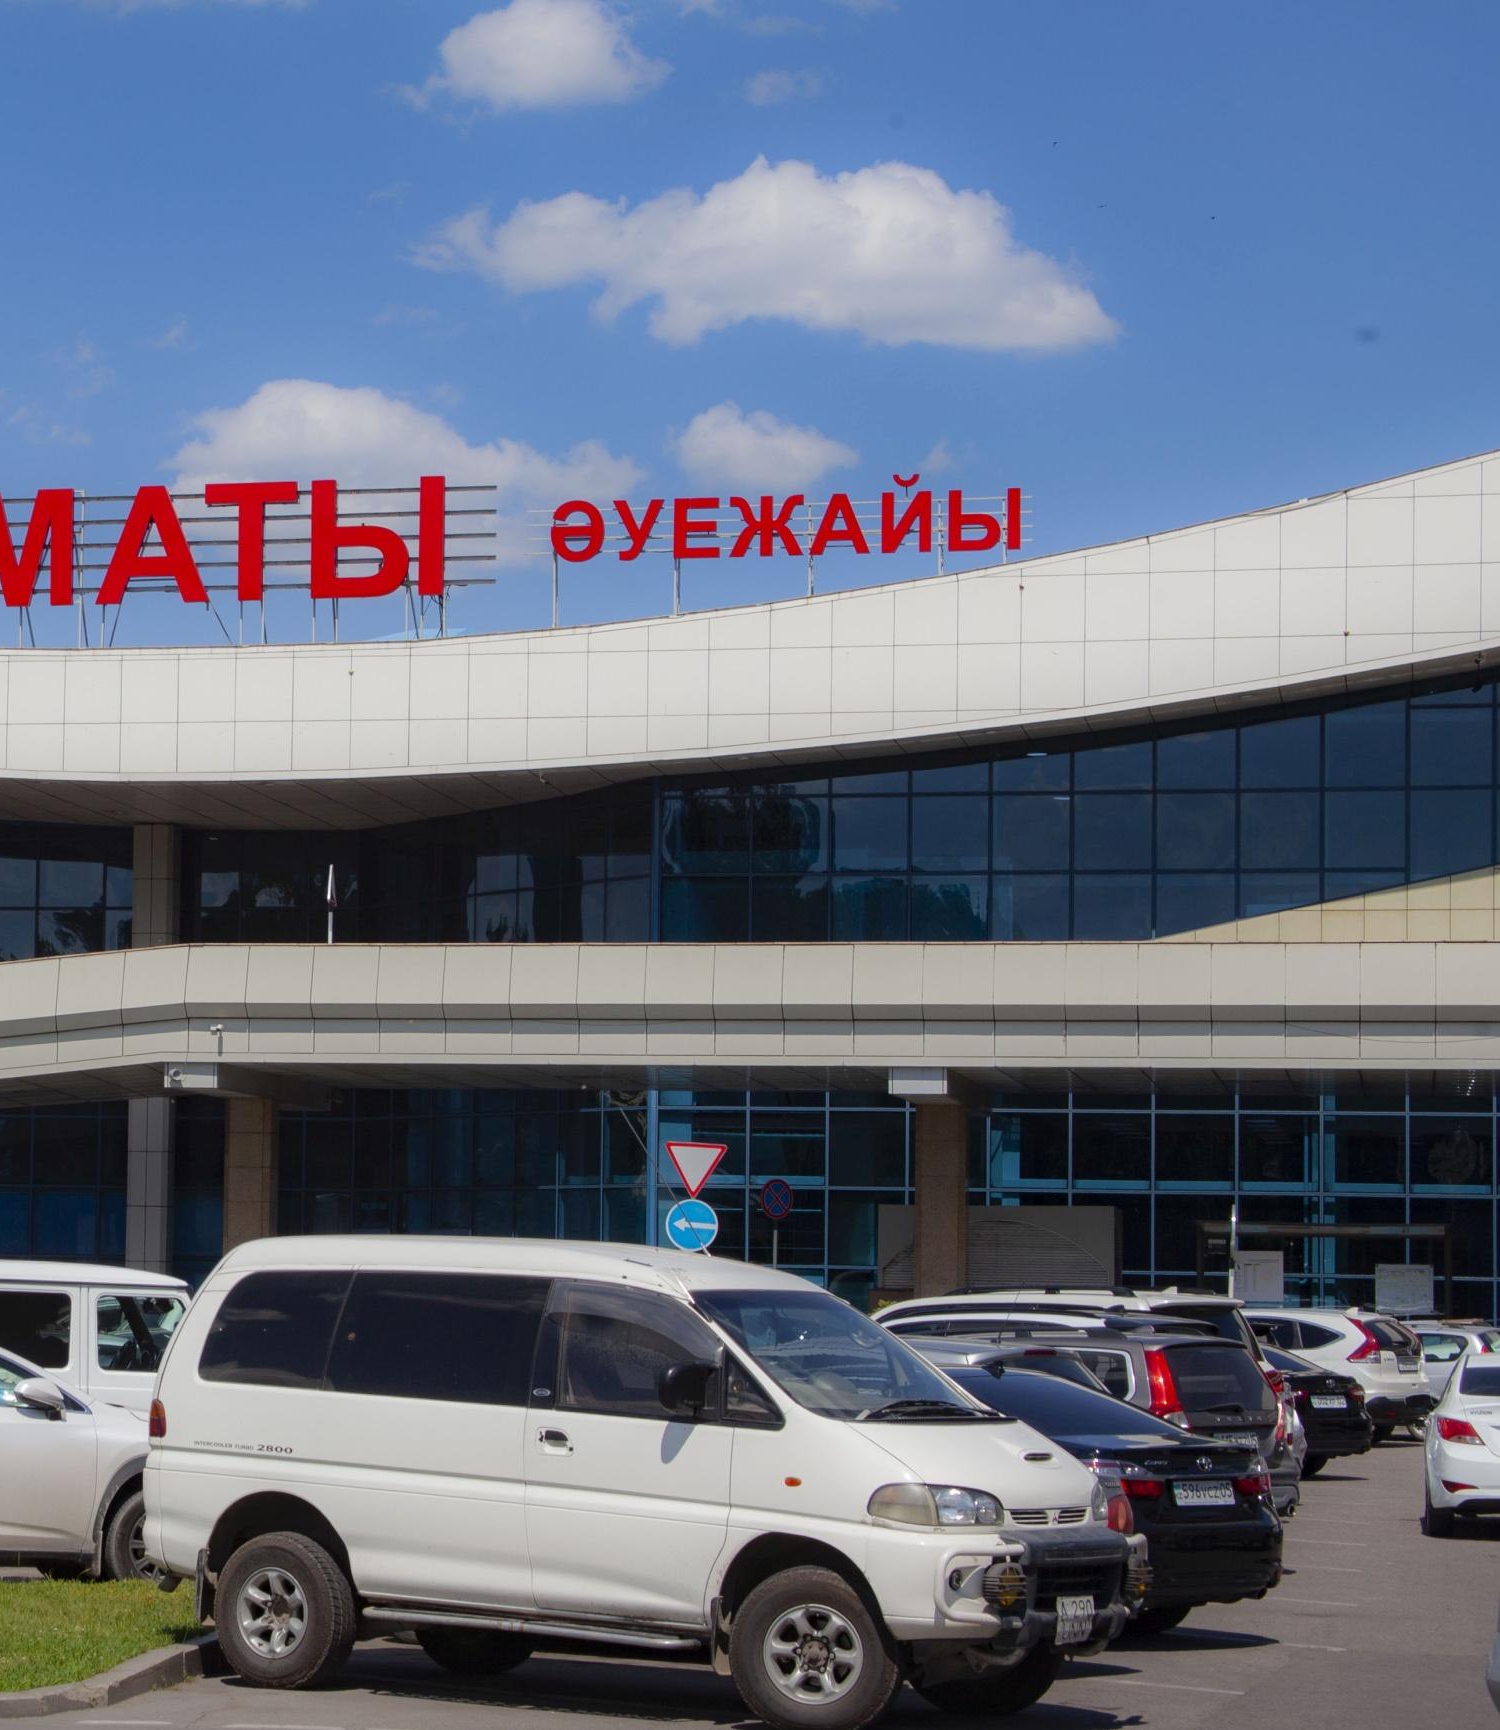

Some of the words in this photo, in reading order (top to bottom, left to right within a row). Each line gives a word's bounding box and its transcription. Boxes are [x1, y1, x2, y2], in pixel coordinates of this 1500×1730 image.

[550, 473, 1021, 563] ӘУЕЖАЙЫ
[256, 1443, 294, 1455] 2800
[1071, 1599, 1093, 1619] 290
